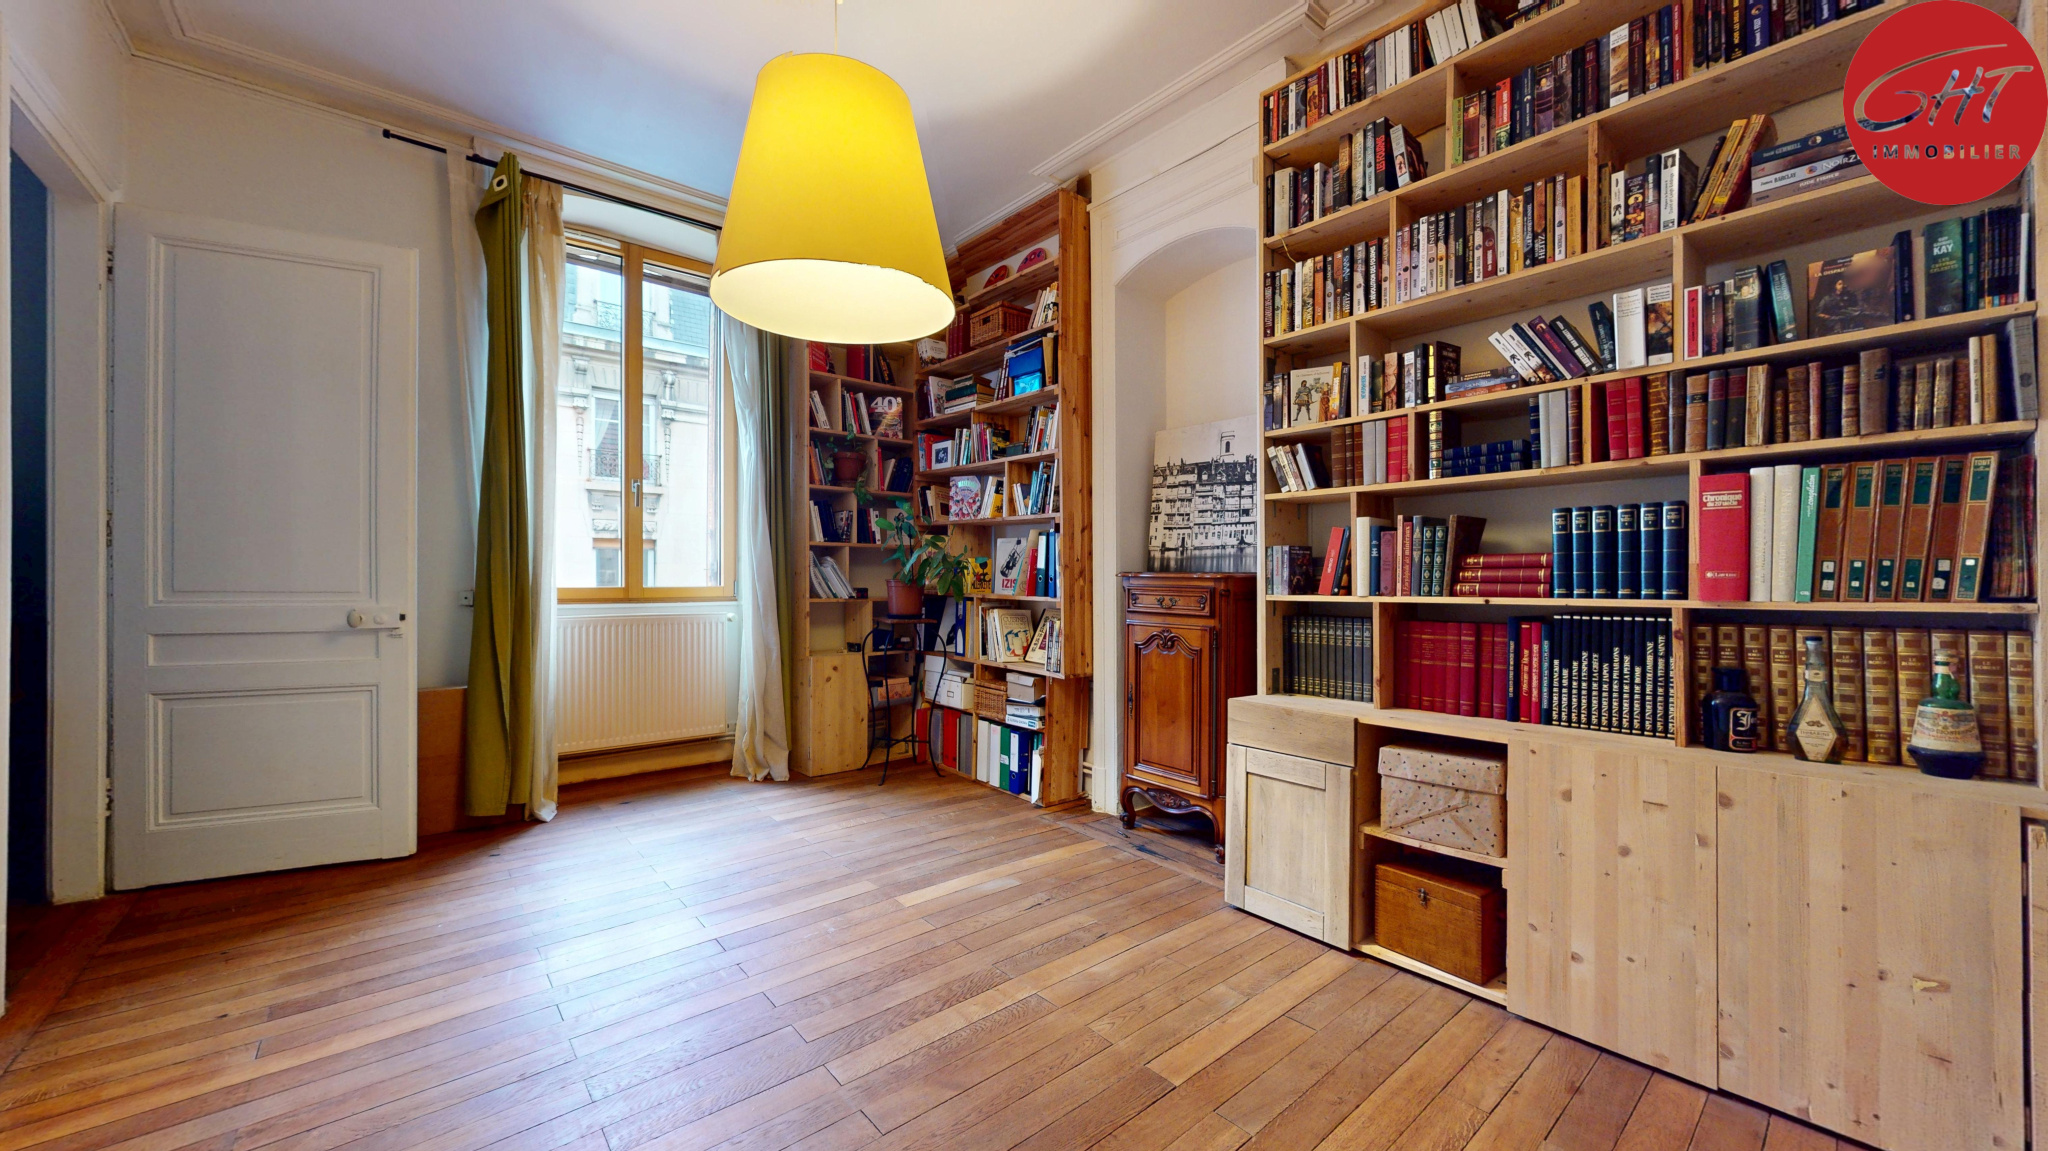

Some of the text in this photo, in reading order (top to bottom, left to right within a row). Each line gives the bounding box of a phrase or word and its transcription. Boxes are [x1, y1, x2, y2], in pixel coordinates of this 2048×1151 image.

[1376, 134, 1386, 172] LES FOURMIS
[1774, 172, 1797, 184] BARCLAY
[1538, 234, 1546, 259] HEITZ
[1933, 244, 1954, 256] KAY
[1421, 265, 1425, 273] LA
[1702, 494, 1742, 503] Chronique
[1002, 578, 1017, 588] IZIS
[1592, 673, 1599, 681] LA
[1612, 646, 1620, 679] PHARAONS
[1572, 680, 1579, 688] DE
[1580, 650, 1589, 724] SPLENDEUR DE L'ESPAGNE
[1592, 681, 1599, 690] DE
[1602, 682, 1609, 691] DU
[1622, 654, 1631, 728] SPLENDEUR DE LA PERSE
[1633, 665, 1642, 729] SPLENDEUR DE ROME
[1656, 634, 1666, 732] SPLENDEUR DE LA TERRE SAINTE
[1552, 687, 1560, 720] SPLENDEUR
[1561, 688, 1569, 721] SPLENDEUR
[1571, 689, 1579, 722] SPLENDEUR
[1591, 691, 1599, 725] SPLENDEUR
[1601, 691, 1609, 726] SPLENDEUR
[1645, 695, 1653, 731] SPLENDEUR
